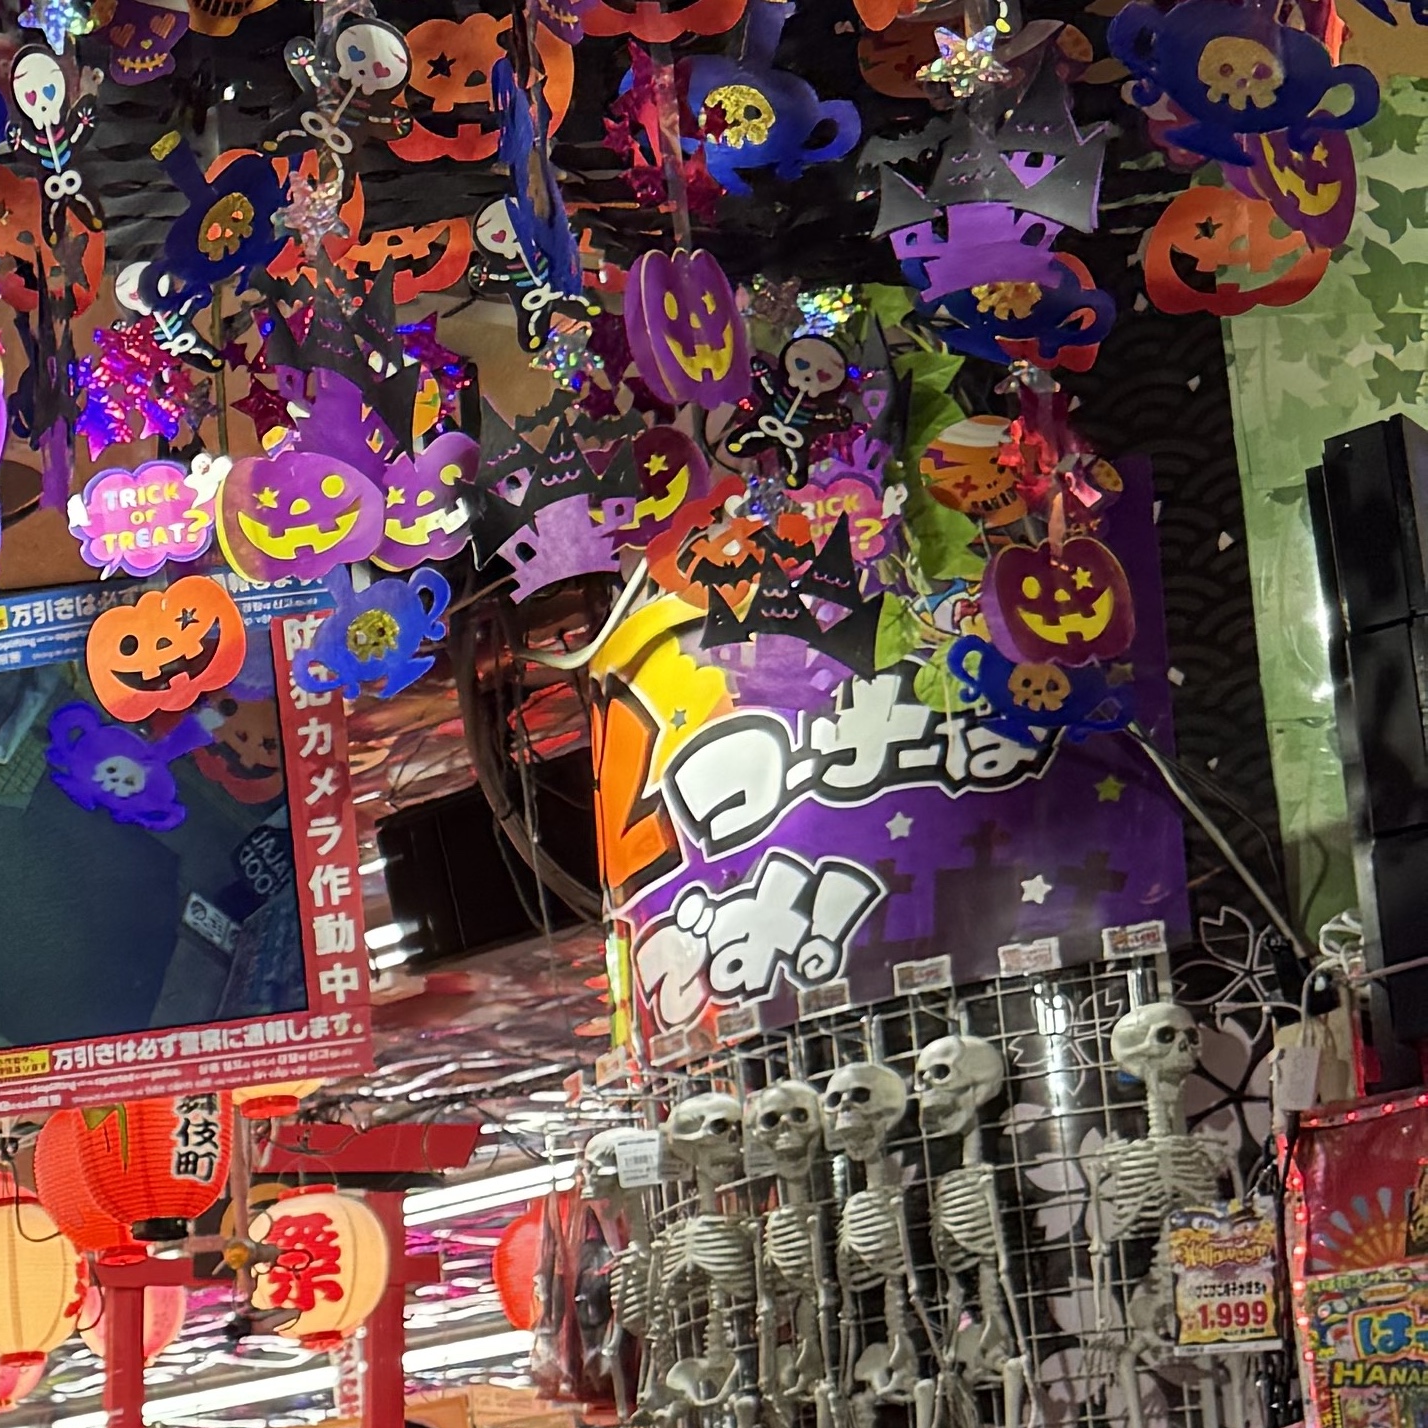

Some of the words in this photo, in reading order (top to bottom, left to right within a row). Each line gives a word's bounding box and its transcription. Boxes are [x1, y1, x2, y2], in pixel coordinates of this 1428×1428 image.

[102, 483, 180, 510] TRICK
[800, 494, 862, 522] RICK
[102, 508, 211, 554] TREAT?
[52, 1010, 364, 1072] 万引きは必ず警察に通報します。
[266, 1211, 346, 1310] 祭
[1197, 1299, 1269, 1330] 1,999
